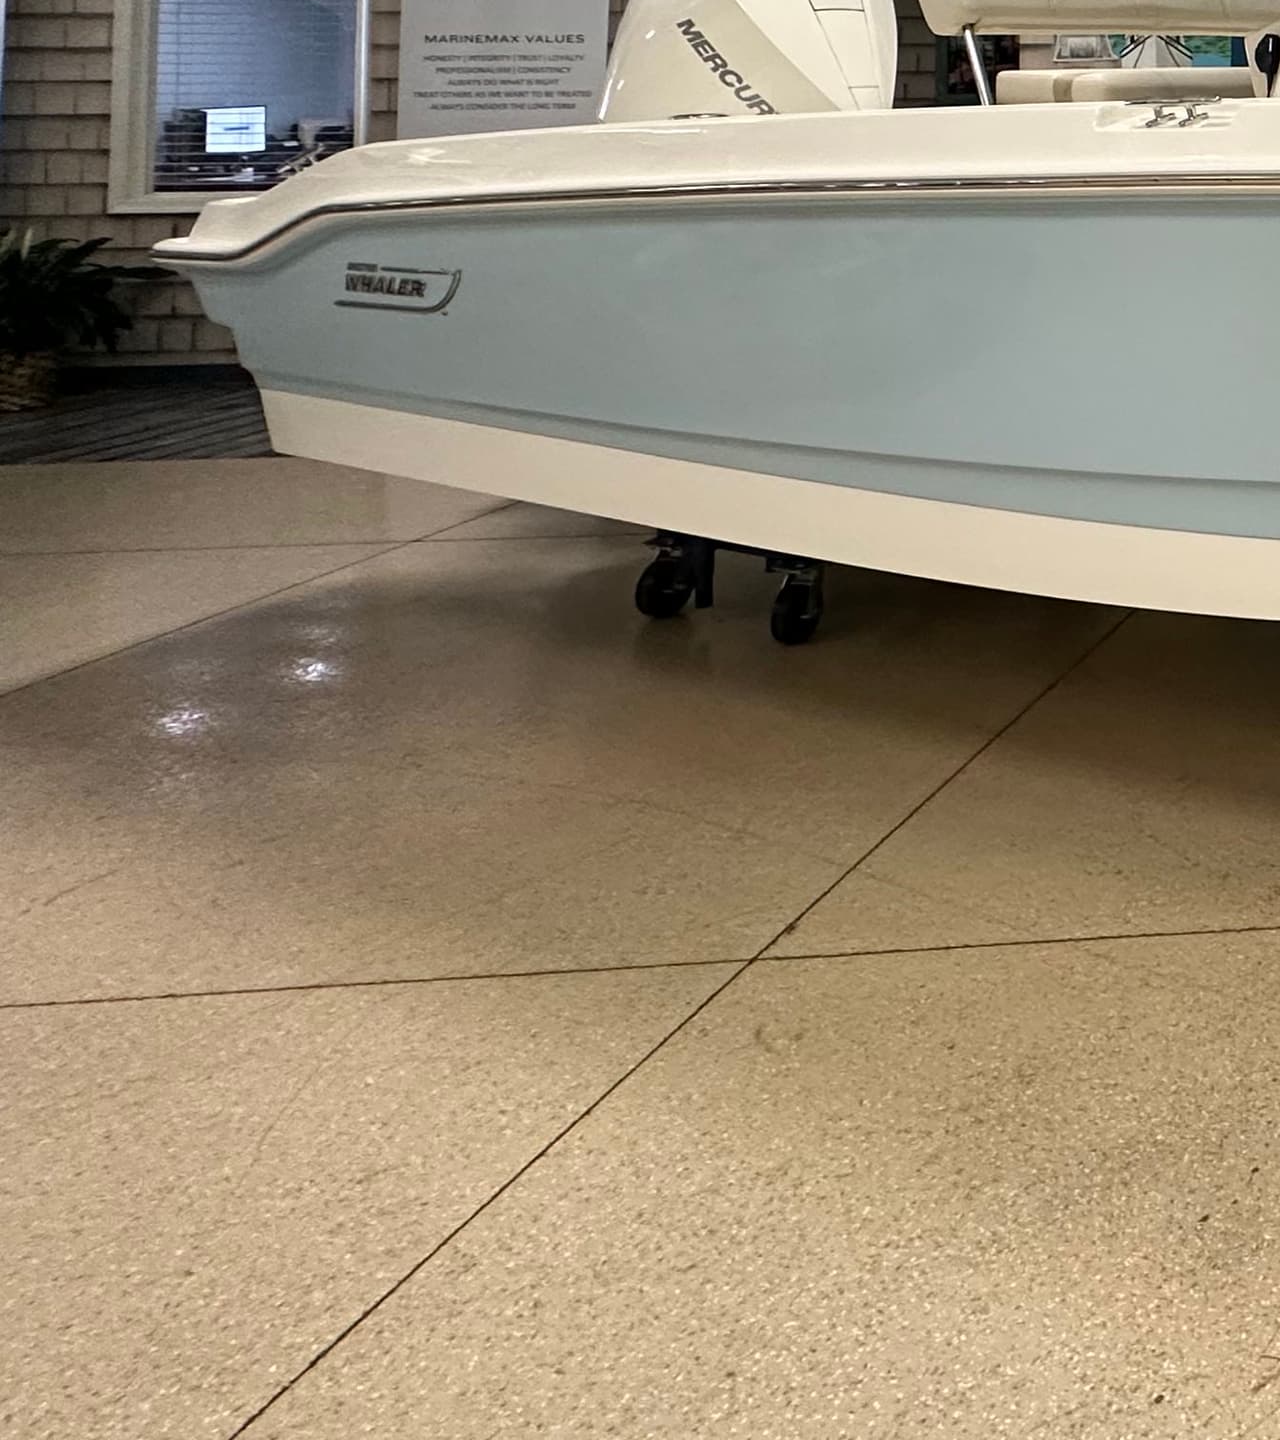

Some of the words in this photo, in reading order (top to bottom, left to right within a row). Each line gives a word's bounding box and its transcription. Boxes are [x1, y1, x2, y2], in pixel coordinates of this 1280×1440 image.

[424, 34, 519, 44] MARINEMAX
[525, 34, 585, 44] VALUES
[676, 18, 781, 115] MERCUR
[345, 273, 426, 297] WHALER
